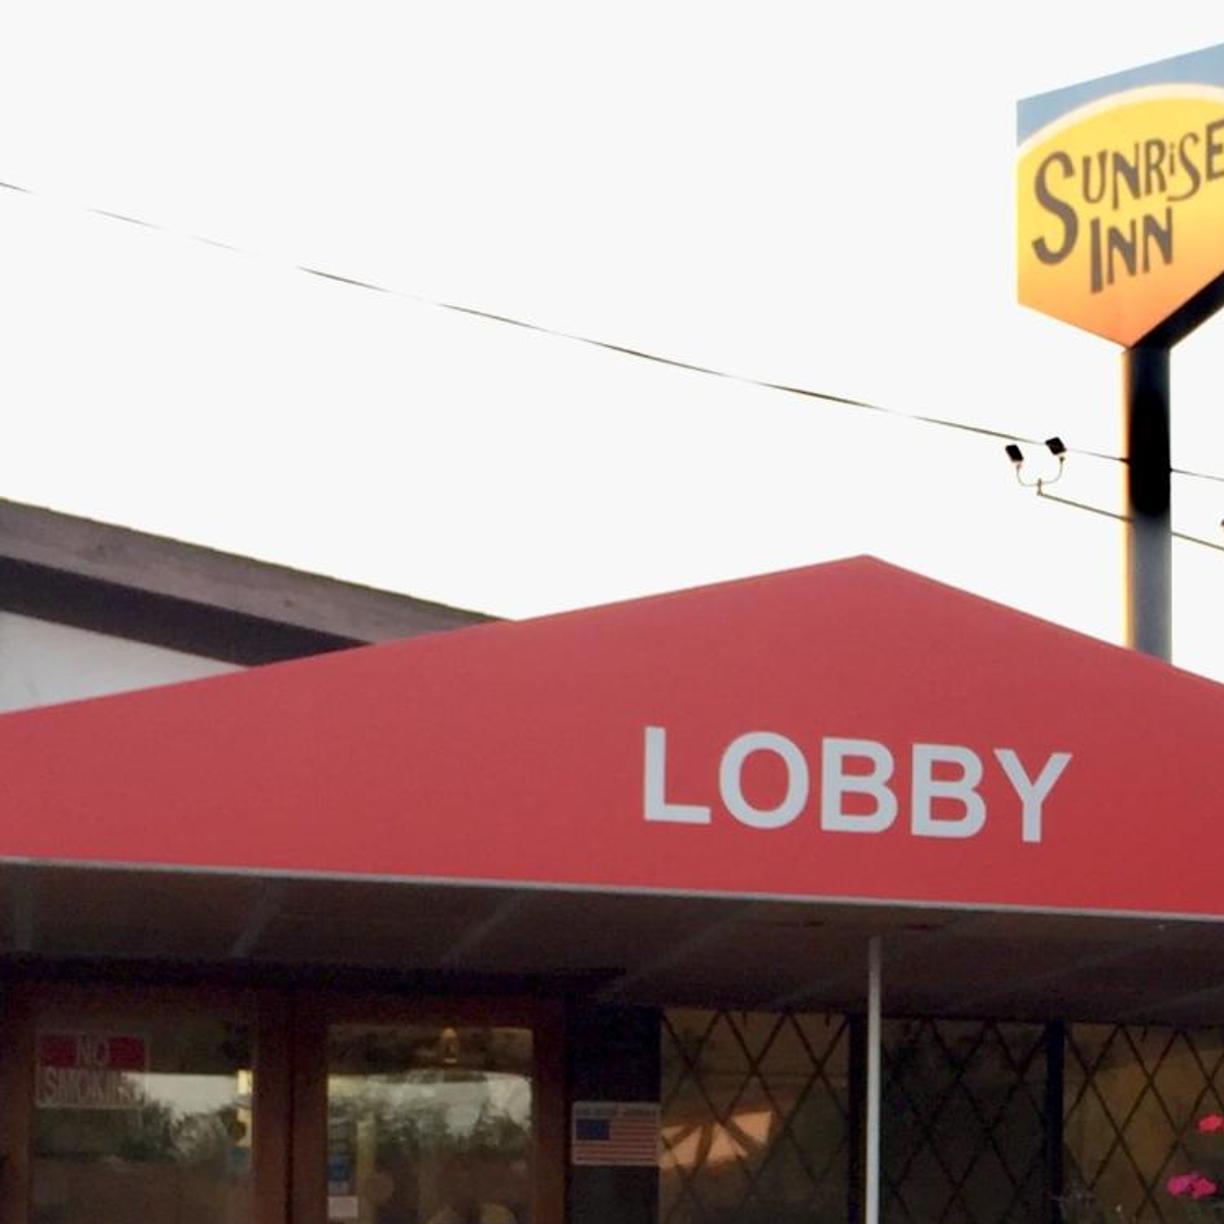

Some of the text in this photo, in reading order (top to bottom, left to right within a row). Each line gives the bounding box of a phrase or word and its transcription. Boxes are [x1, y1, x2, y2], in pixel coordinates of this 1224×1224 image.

[1090, 206, 1173, 294] INN
[643, 726, 1073, 843] LOBBY
[75, 1037, 111, 1066] NO
